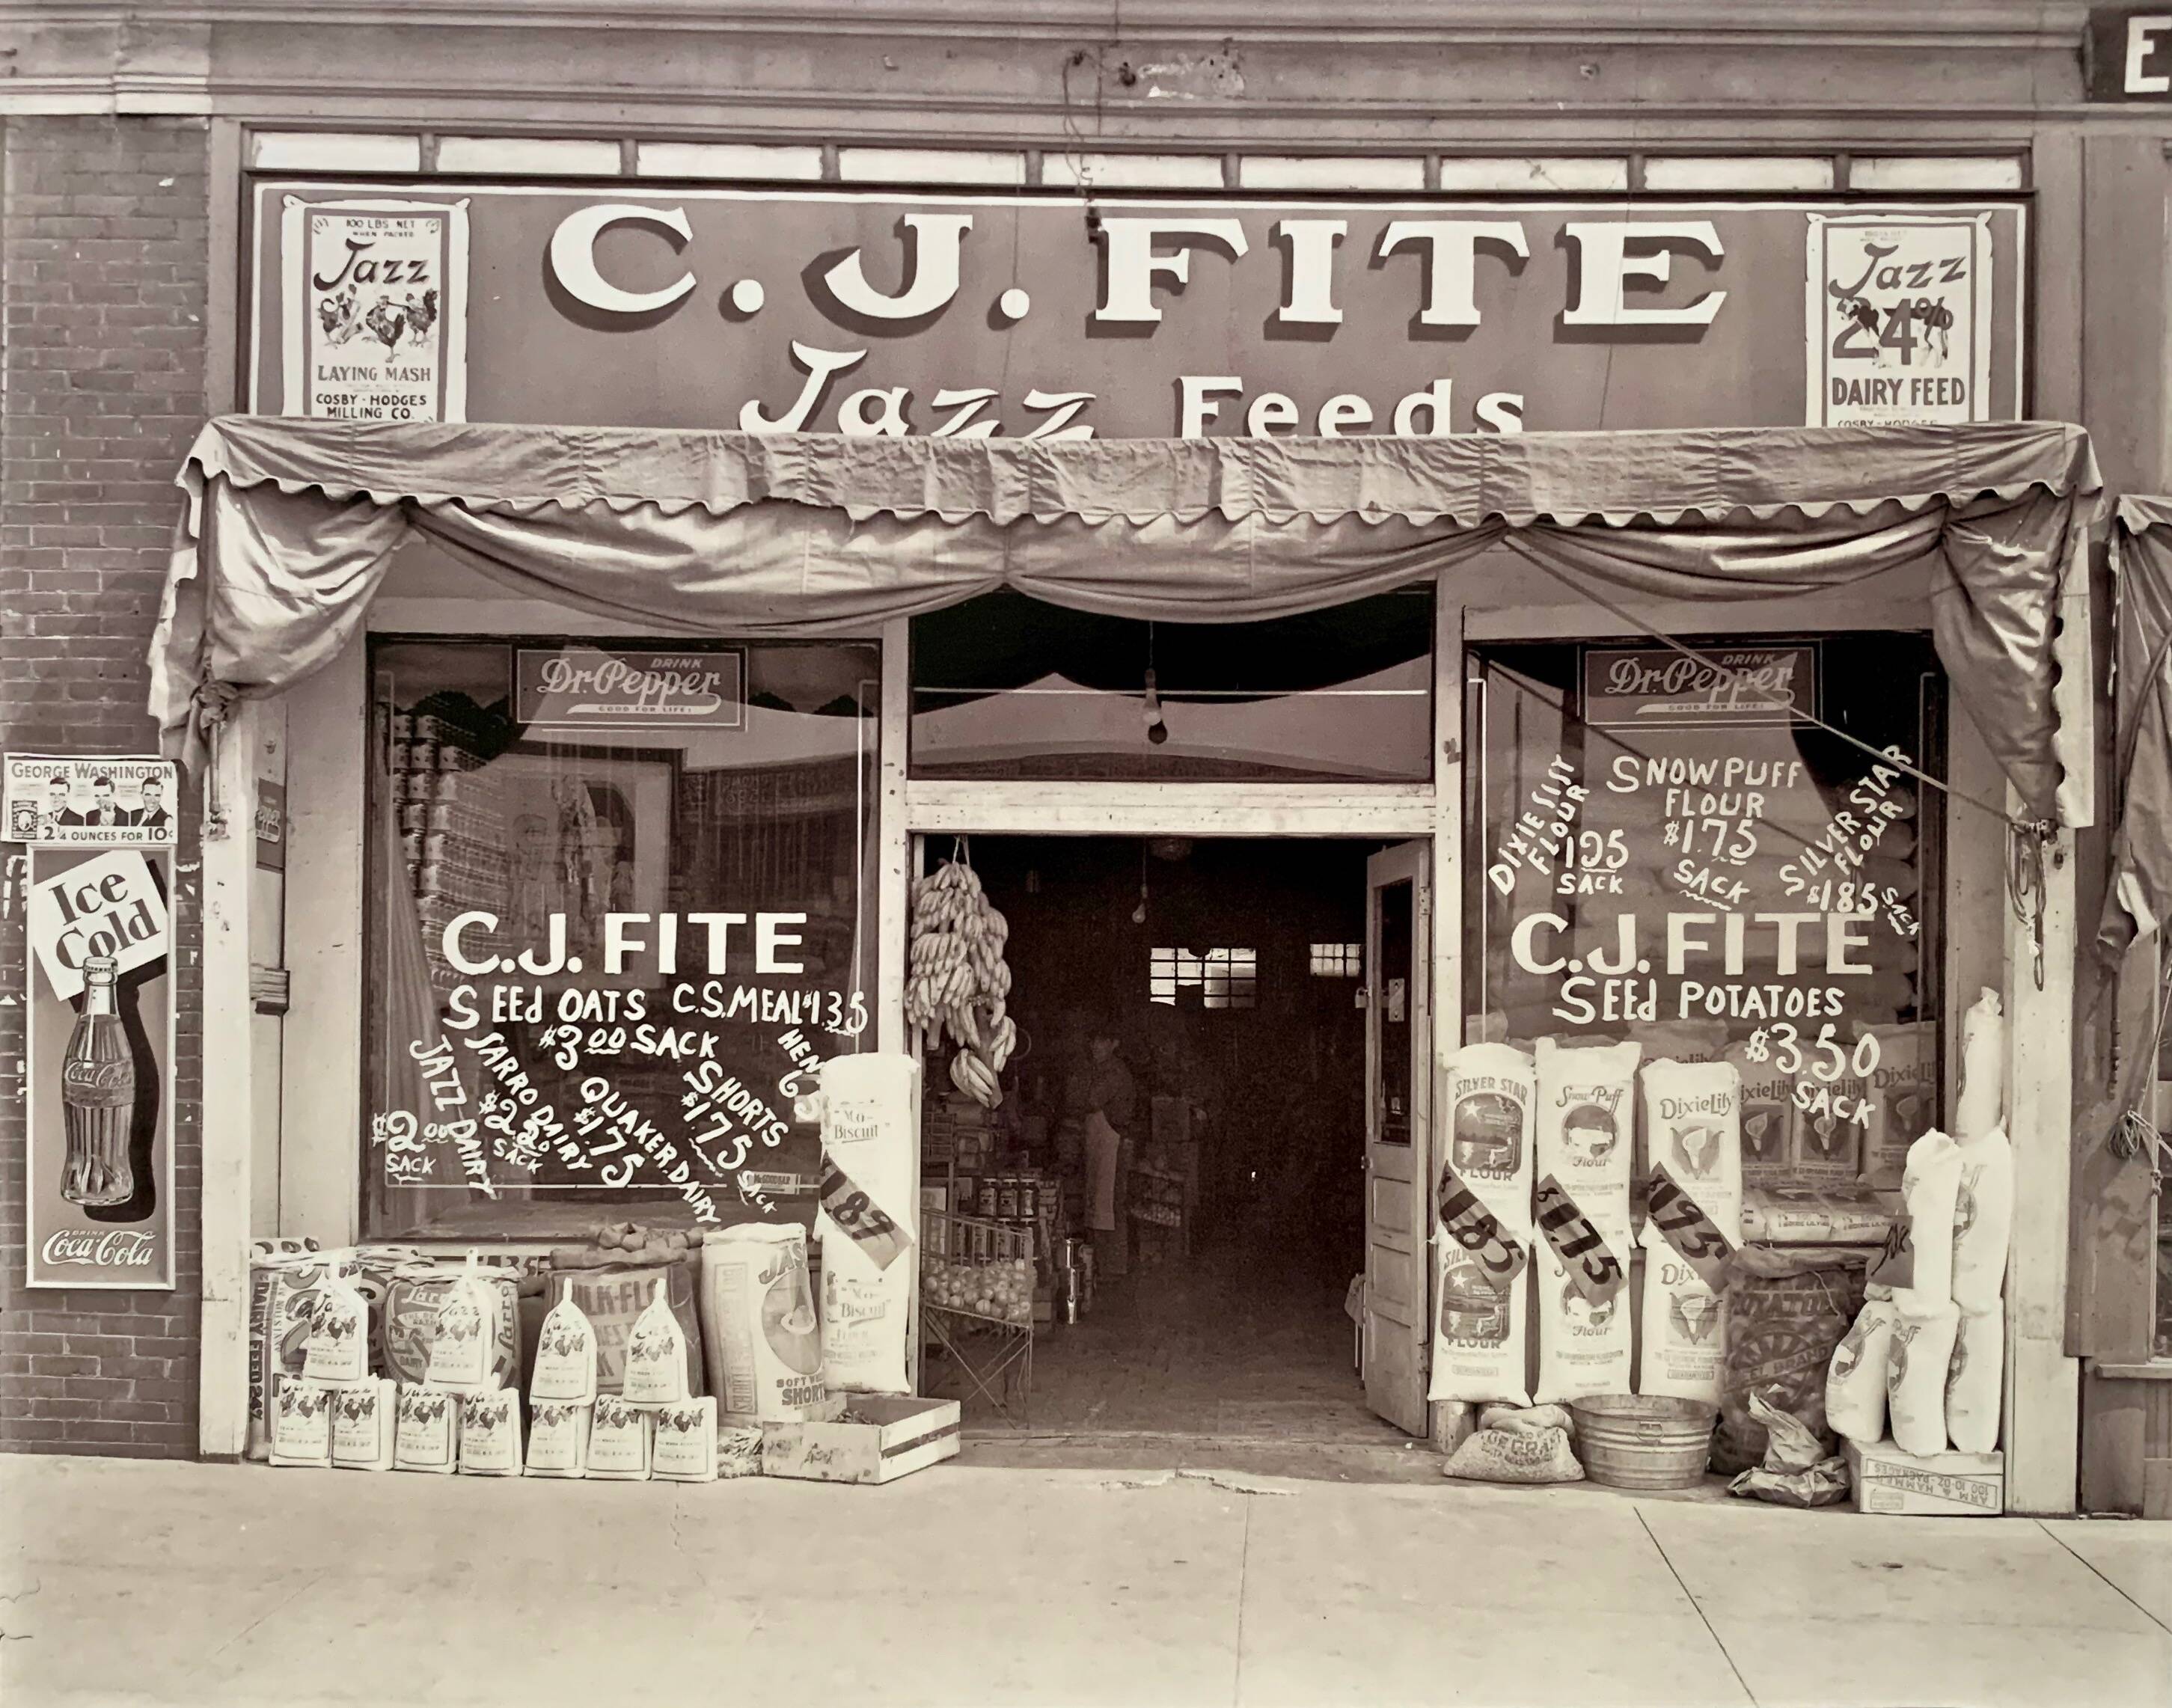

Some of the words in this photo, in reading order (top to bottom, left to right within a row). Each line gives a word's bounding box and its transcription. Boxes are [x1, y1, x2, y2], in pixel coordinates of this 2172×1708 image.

[313, 238, 429, 291] Jazz
[1095, 218, 1728, 325] FITE
[1829, 242, 1966, 299] Jazz
[1832, 296, 1954, 365] 24%
[318, 366, 377, 382] LAYING
[385, 367, 430, 382] MASH
[740, 340, 1095, 440] Jazz
[1182, 376, 1524, 438] Feeds
[1832, 377, 1903, 406] DAIRY
[1911, 378, 1965, 405] FEED
[316, 394, 357, 405] COSBY
[370, 394, 426, 405] HODGES
[327, 407, 382, 419] MILLING
[650, 658, 703, 668] DRINK
[1722, 654, 1775, 664] DRINK
[12, 762, 70, 779] GEORGE
[75, 762, 173, 779] WASHINGTON
[1665, 789, 1765, 818] FLOUR
[1779, 811, 1862, 896] SILVER
[1850, 745, 1914, 814] STAR
[71, 831, 117, 841] OUNCES
[121, 831, 143, 840] FOR
[1526, 783, 1589, 875] FLOUR
[1835, 800, 1903, 875] FLOUR
[1488, 809, 1545, 896] DIXIE
[49, 874, 129, 926] Ice
[1557, 873, 1623, 895] SACK
[1674, 859, 1751, 904] SACK
[56, 898, 161, 970] Cold
[605, 912, 807, 975] FITE
[1667, 913, 1874, 975] FITE
[558, 988, 646, 1023] OATS
[1679, 982, 1845, 1020] POTATOES
[630, 1023, 720, 1059] SACK
[1745, 1023, 1880, 1081] $3.50
[683, 1061, 789, 1147] SHORTS
[1455, 1077, 1496, 1100] SILVER
[1500, 1078, 1528, 1106] STAR
[1591, 1086, 1624, 1115] Puff
[1740, 1080, 1790, 1104] ixieLily
[1790, 1081, 1876, 1129] SACK
[409, 1034, 467, 1111] JAZZ
[448, 1119, 498, 1200] DAIRY
[530, 1105, 593, 1169] DAIRY
[386, 1153, 436, 1175] SACK
[493, 1138, 542, 1174] SACK
[573, 1106, 645, 1187] $1.75
[737, 1170, 777, 1213] SACK
[249, 1282, 269, 1335] DAIRY
[249, 1340, 263, 1383] FEED
